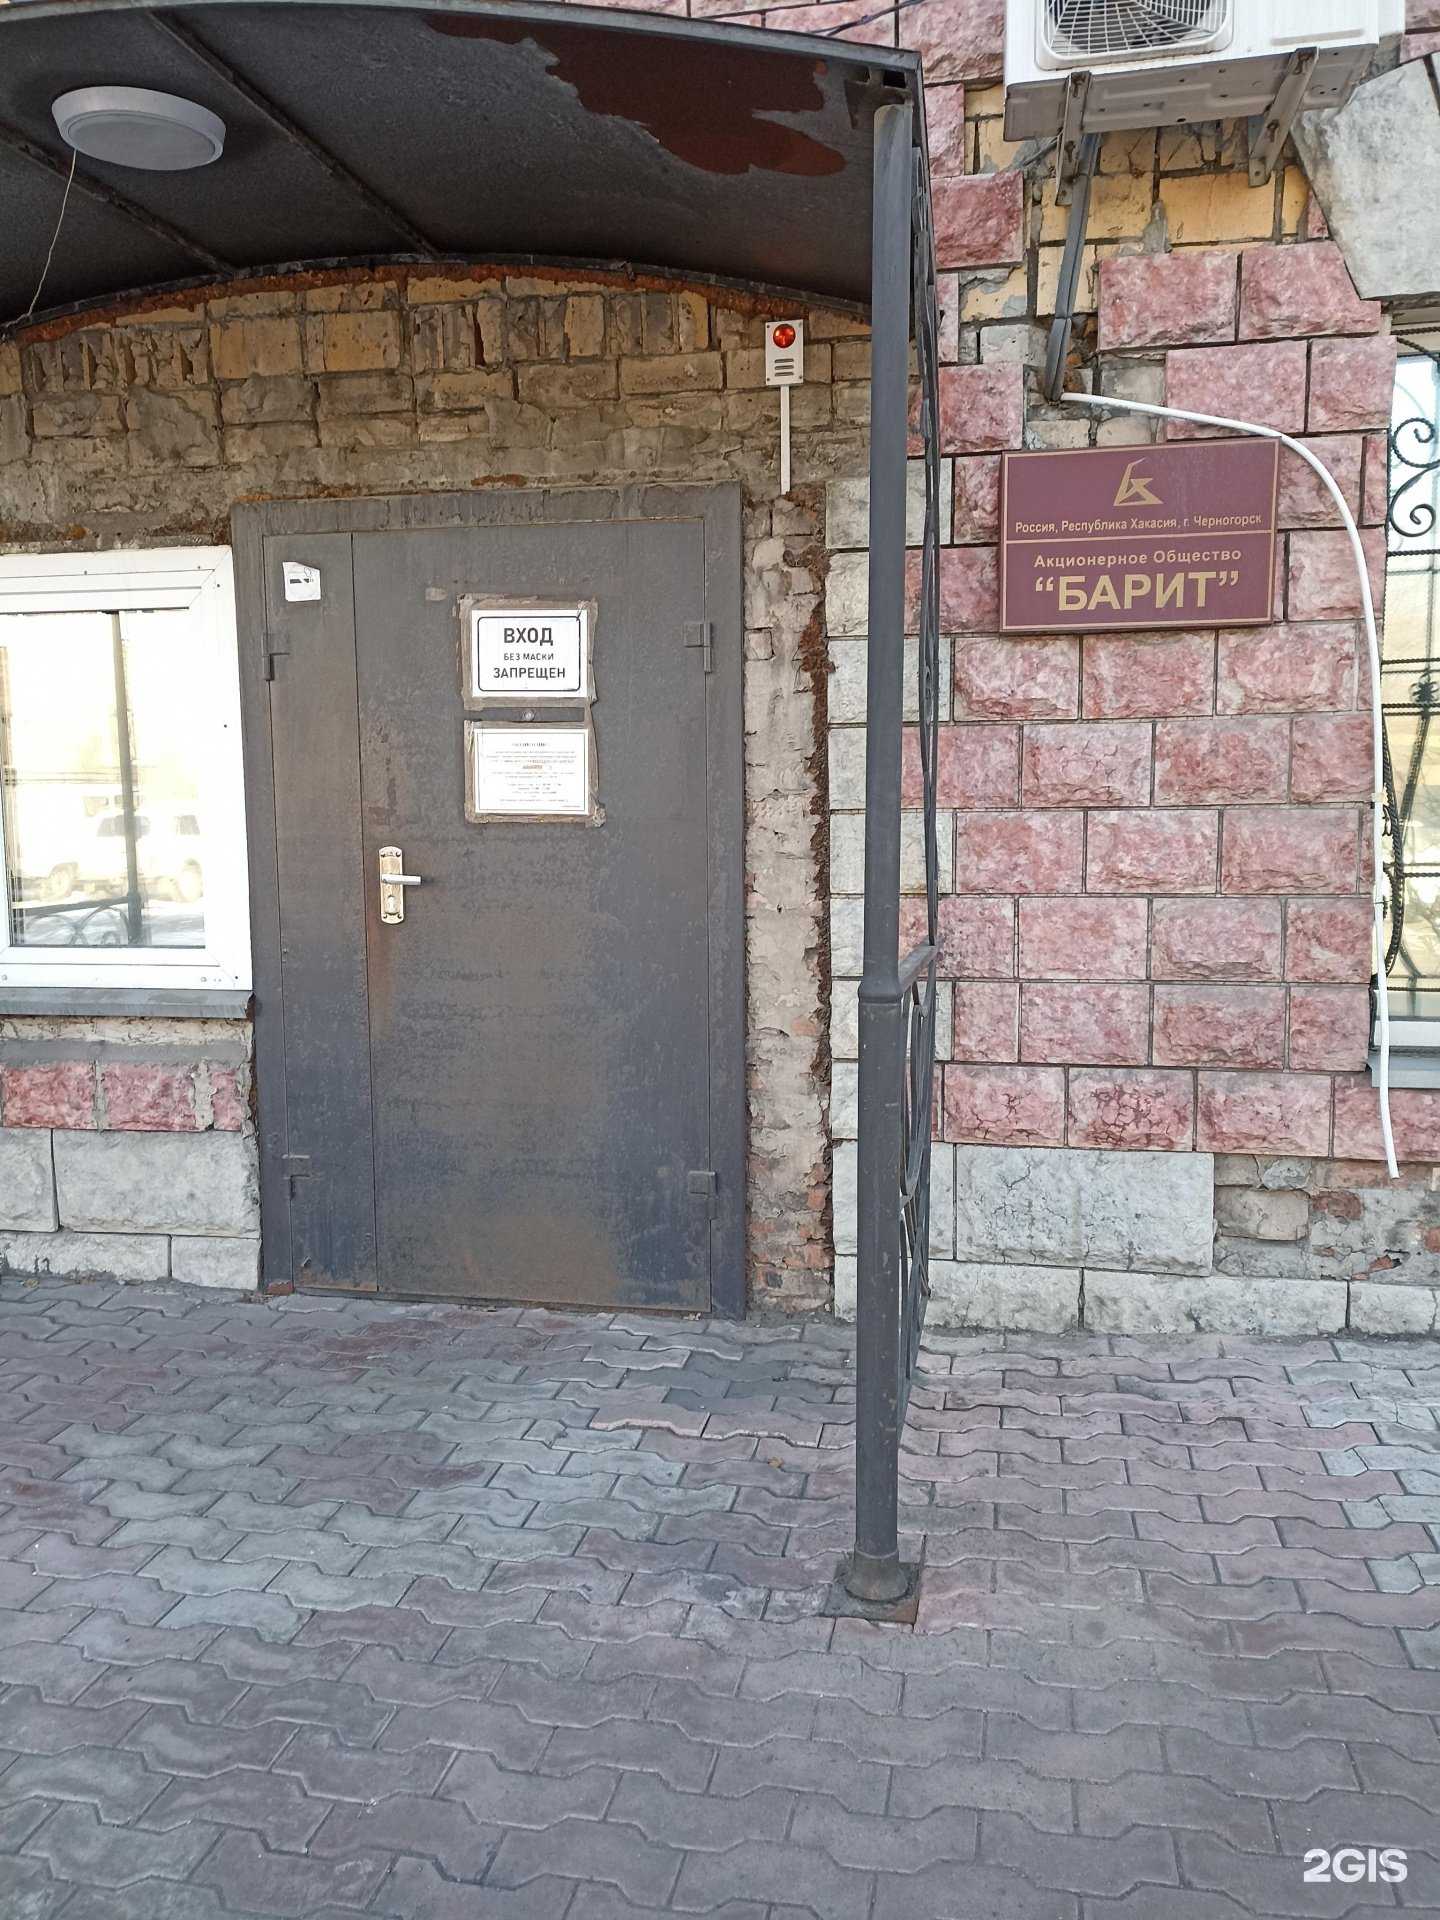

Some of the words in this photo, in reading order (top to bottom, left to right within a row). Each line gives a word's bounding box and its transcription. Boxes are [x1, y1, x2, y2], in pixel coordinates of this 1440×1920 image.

[1015, 521, 1058, 534] Россия,
[1061, 519, 1127, 532] Республика
[1193, 514, 1262, 527] Черногорск
[1034, 553, 1147, 569] Акционерное
[1153, 550, 1242, 564] Общество
[1035, 570, 1239, 611] “БАРИТ”
[503, 627, 554, 646] ВХОД
[503, 653, 520, 661] БЕЗ
[523, 652, 554, 661] МАСКИ
[493, 667, 565, 680] ЗАПРЕЩЕН
